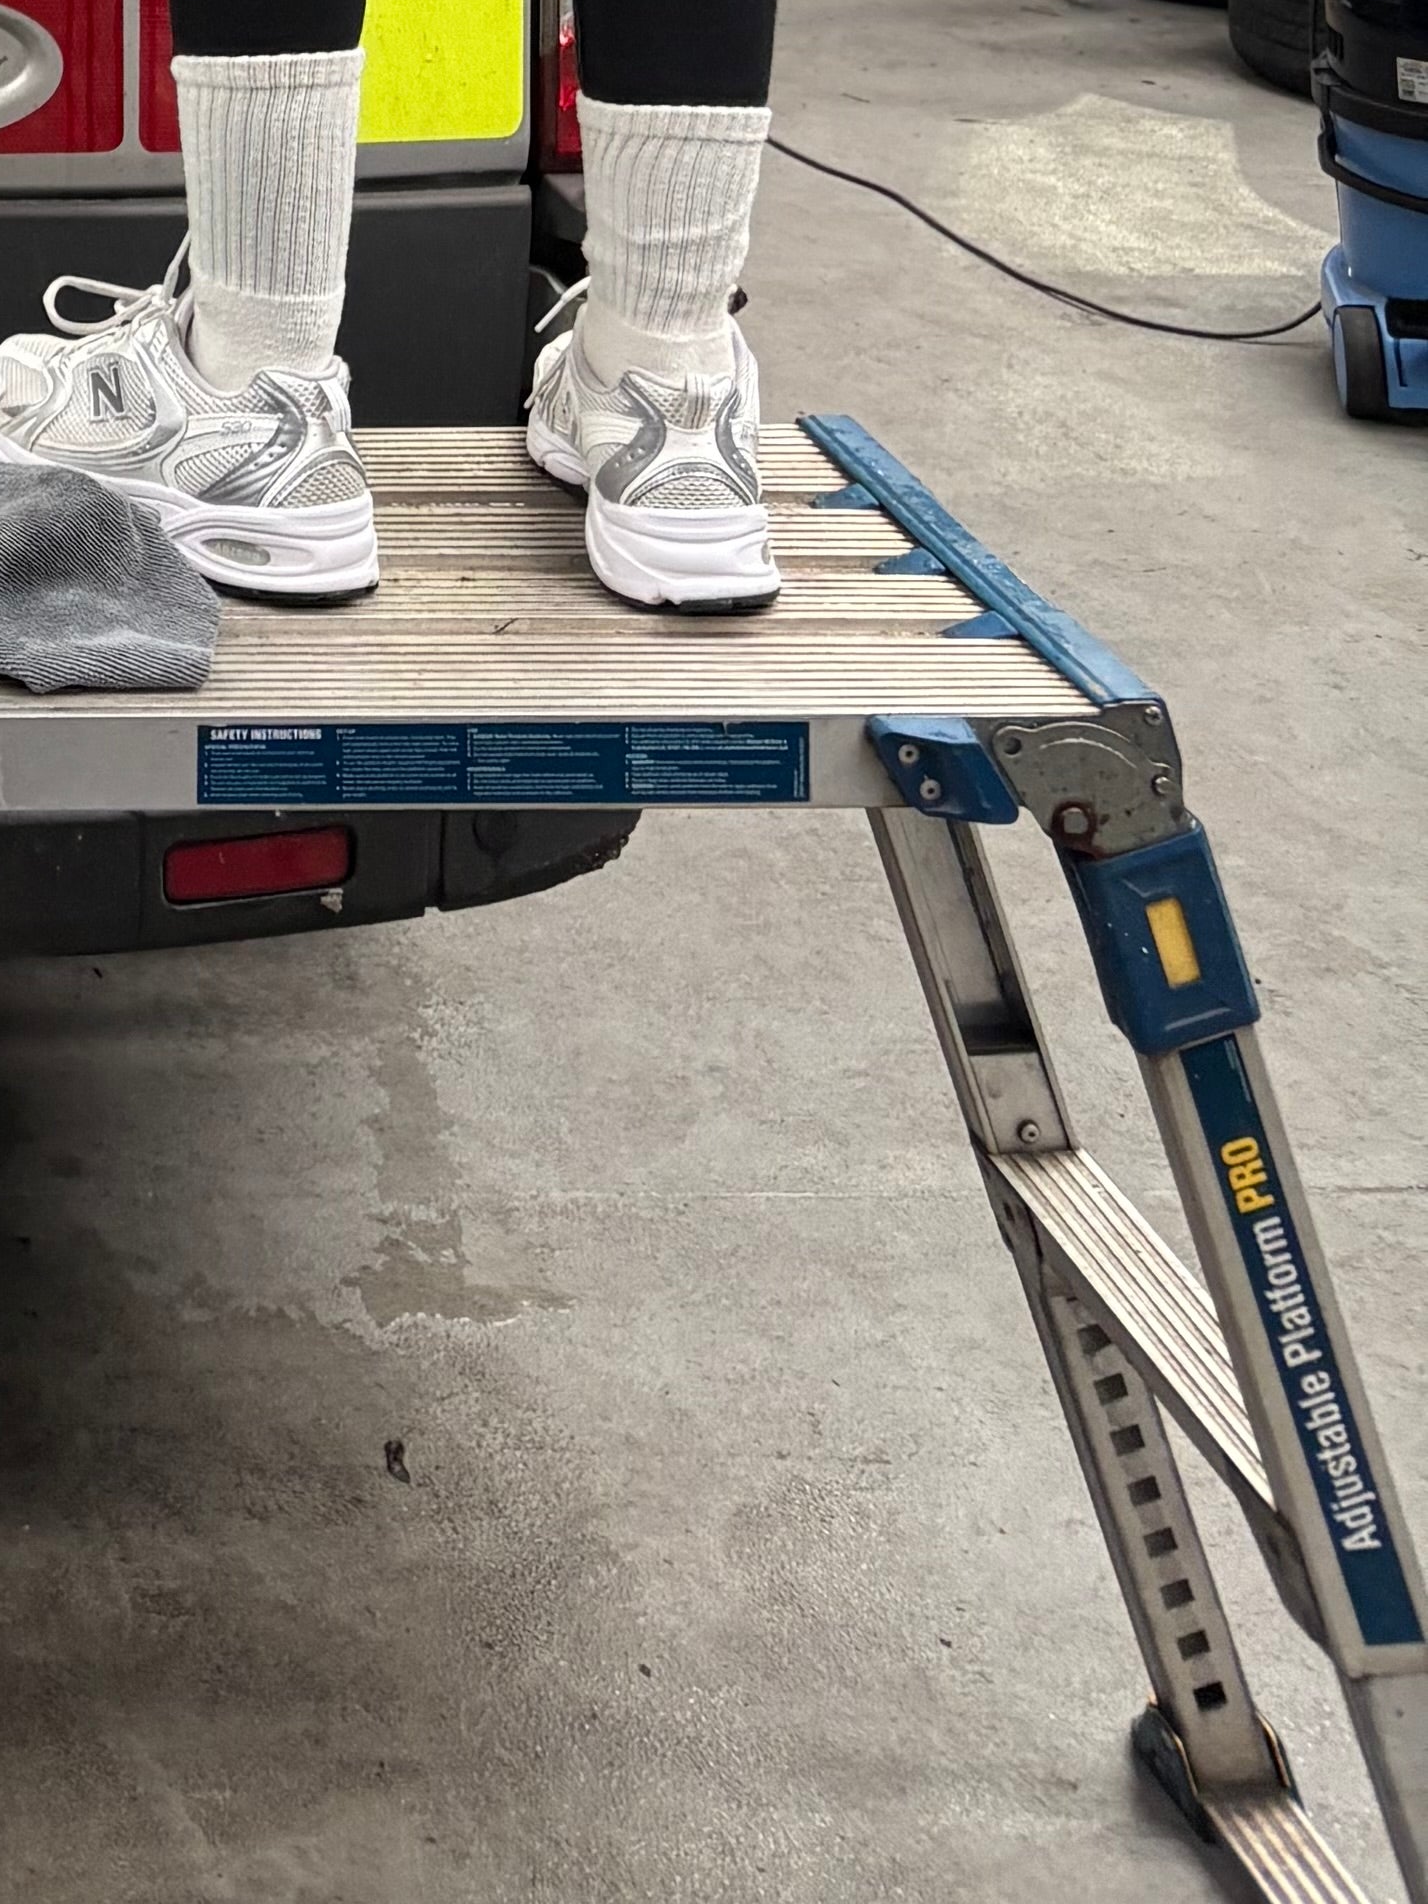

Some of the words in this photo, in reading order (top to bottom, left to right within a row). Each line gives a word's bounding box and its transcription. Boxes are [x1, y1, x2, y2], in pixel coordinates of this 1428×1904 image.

[88, 363, 126, 422] N
[210, 729, 248, 742] SAFETY
[250, 728, 323, 741] INSTRUCTIONS
[1220, 1136, 1275, 1213] PRO
[1253, 1215, 1323, 1368] Platform
[1300, 1371, 1382, 1551] Adjustable
